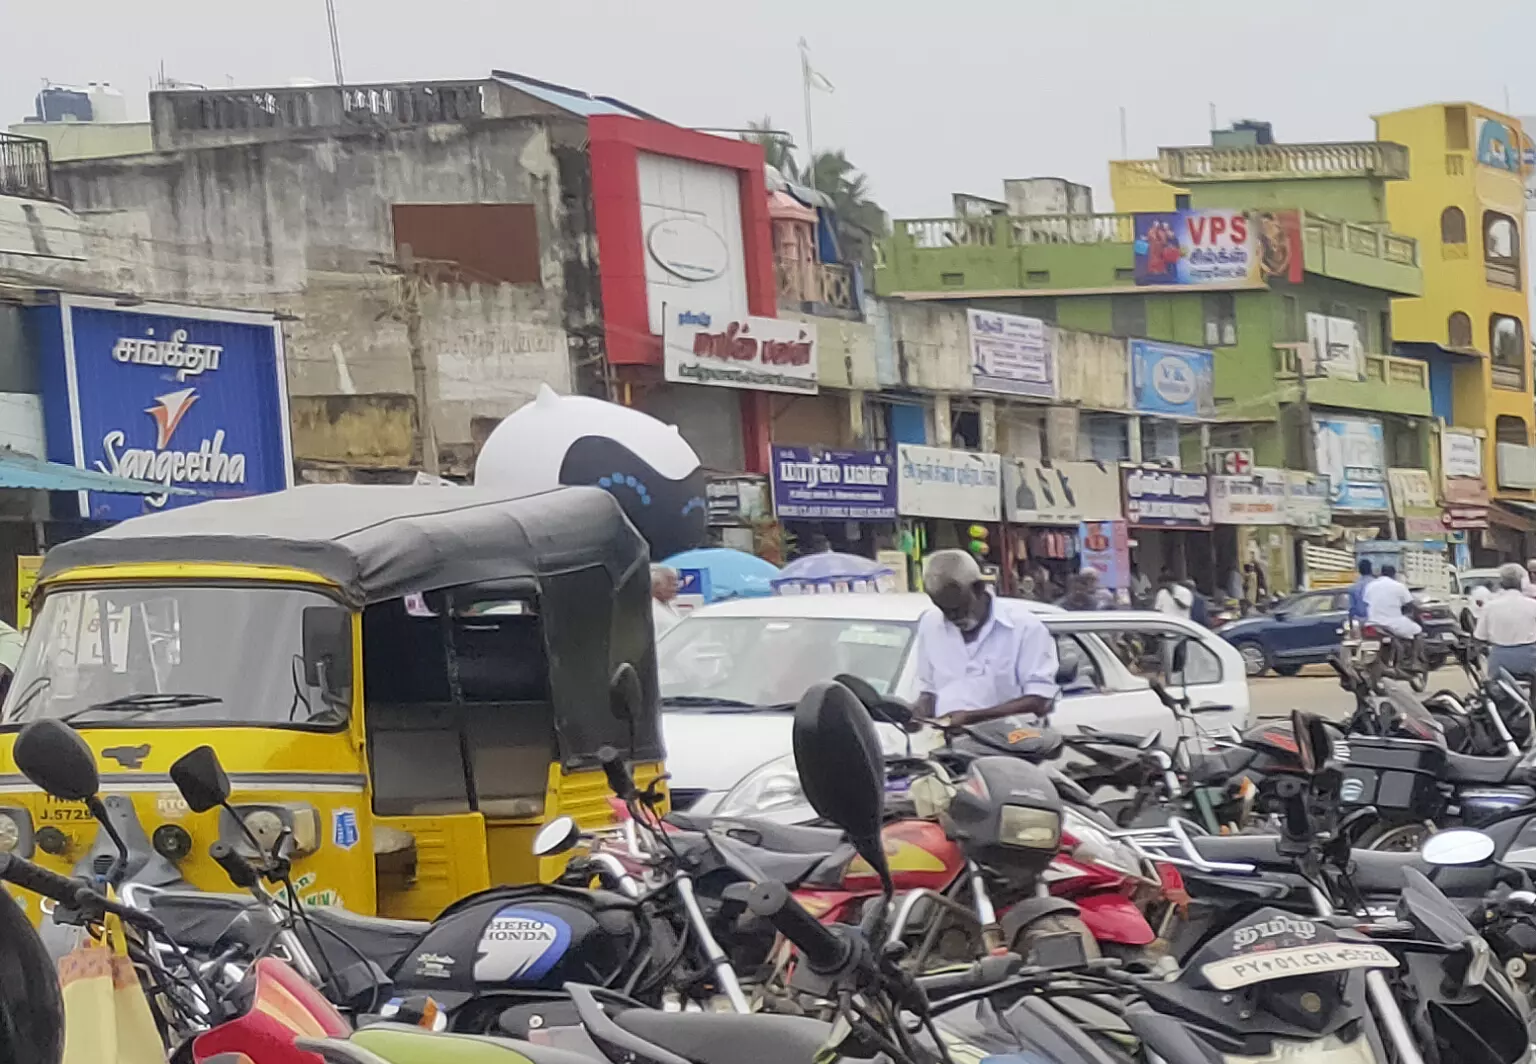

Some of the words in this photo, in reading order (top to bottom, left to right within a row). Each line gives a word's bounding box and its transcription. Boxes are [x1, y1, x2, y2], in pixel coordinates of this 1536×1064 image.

[1187, 216, 1248, 245] VPS
[112, 328, 224, 382] சங்கீதா
[94, 429, 245, 507] Sangeetha
